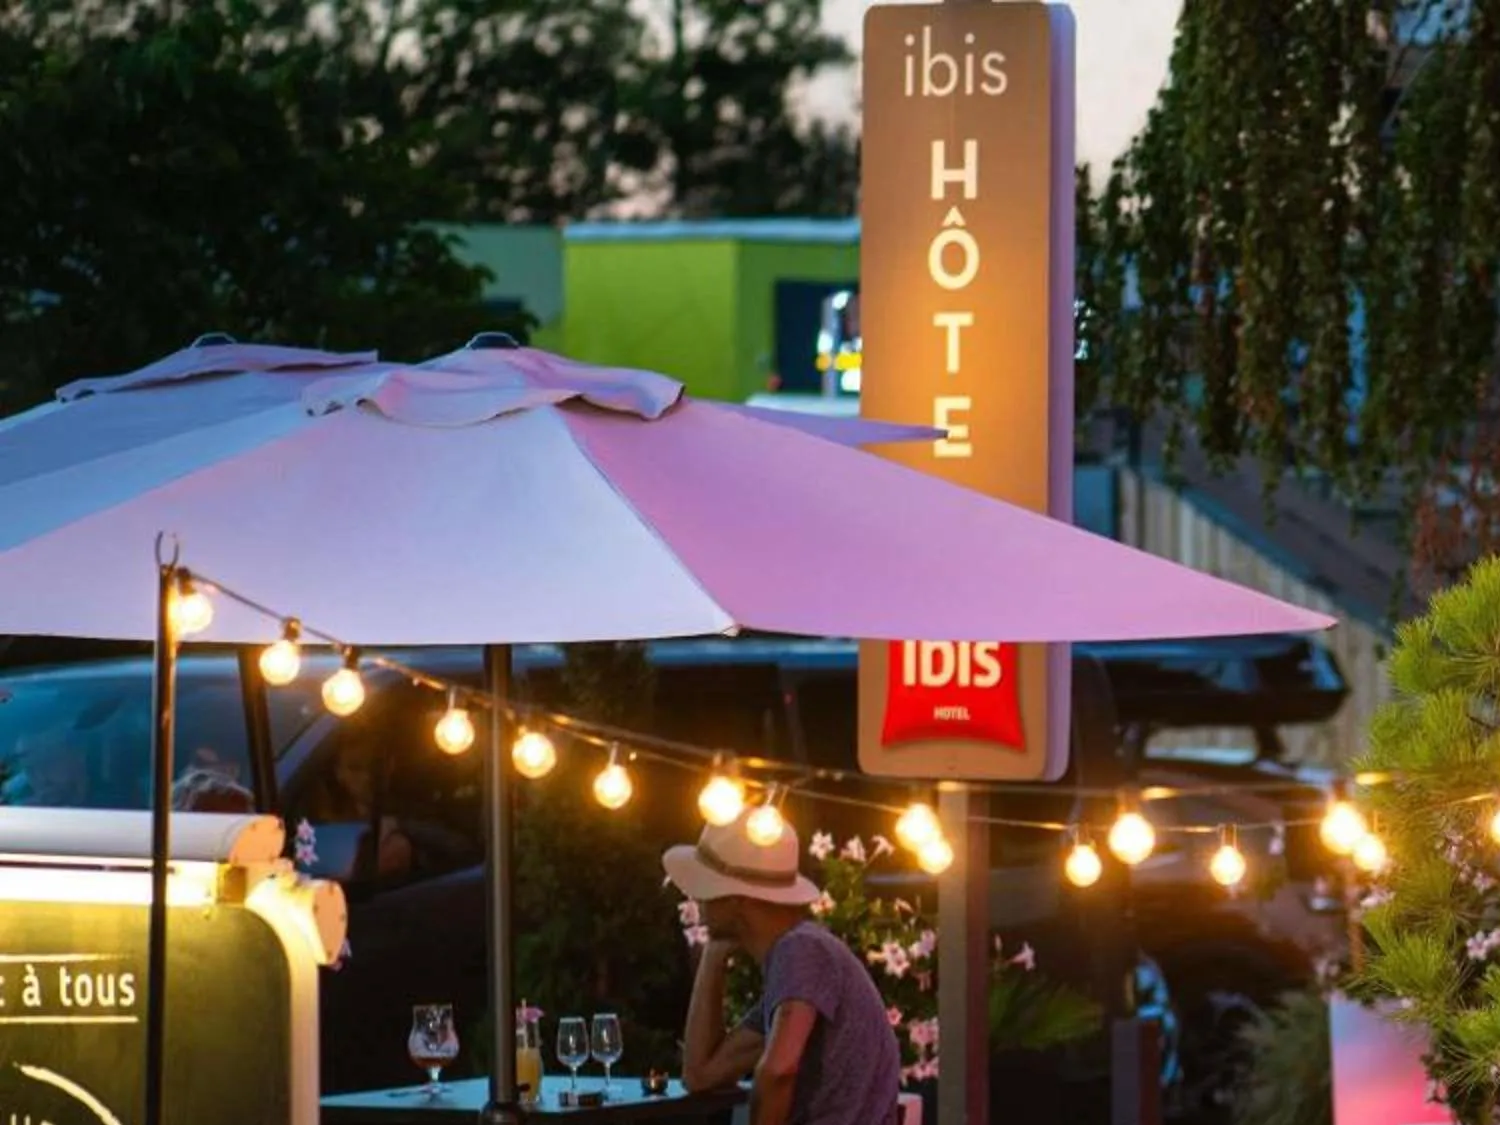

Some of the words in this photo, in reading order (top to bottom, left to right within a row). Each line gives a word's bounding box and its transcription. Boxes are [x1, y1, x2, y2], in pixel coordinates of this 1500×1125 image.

[904, 25, 1008, 97] ibis
[933, 705, 971, 721] HOTEL
[22, 963, 42, 1007] à
[59, 965, 136, 1007] tous
